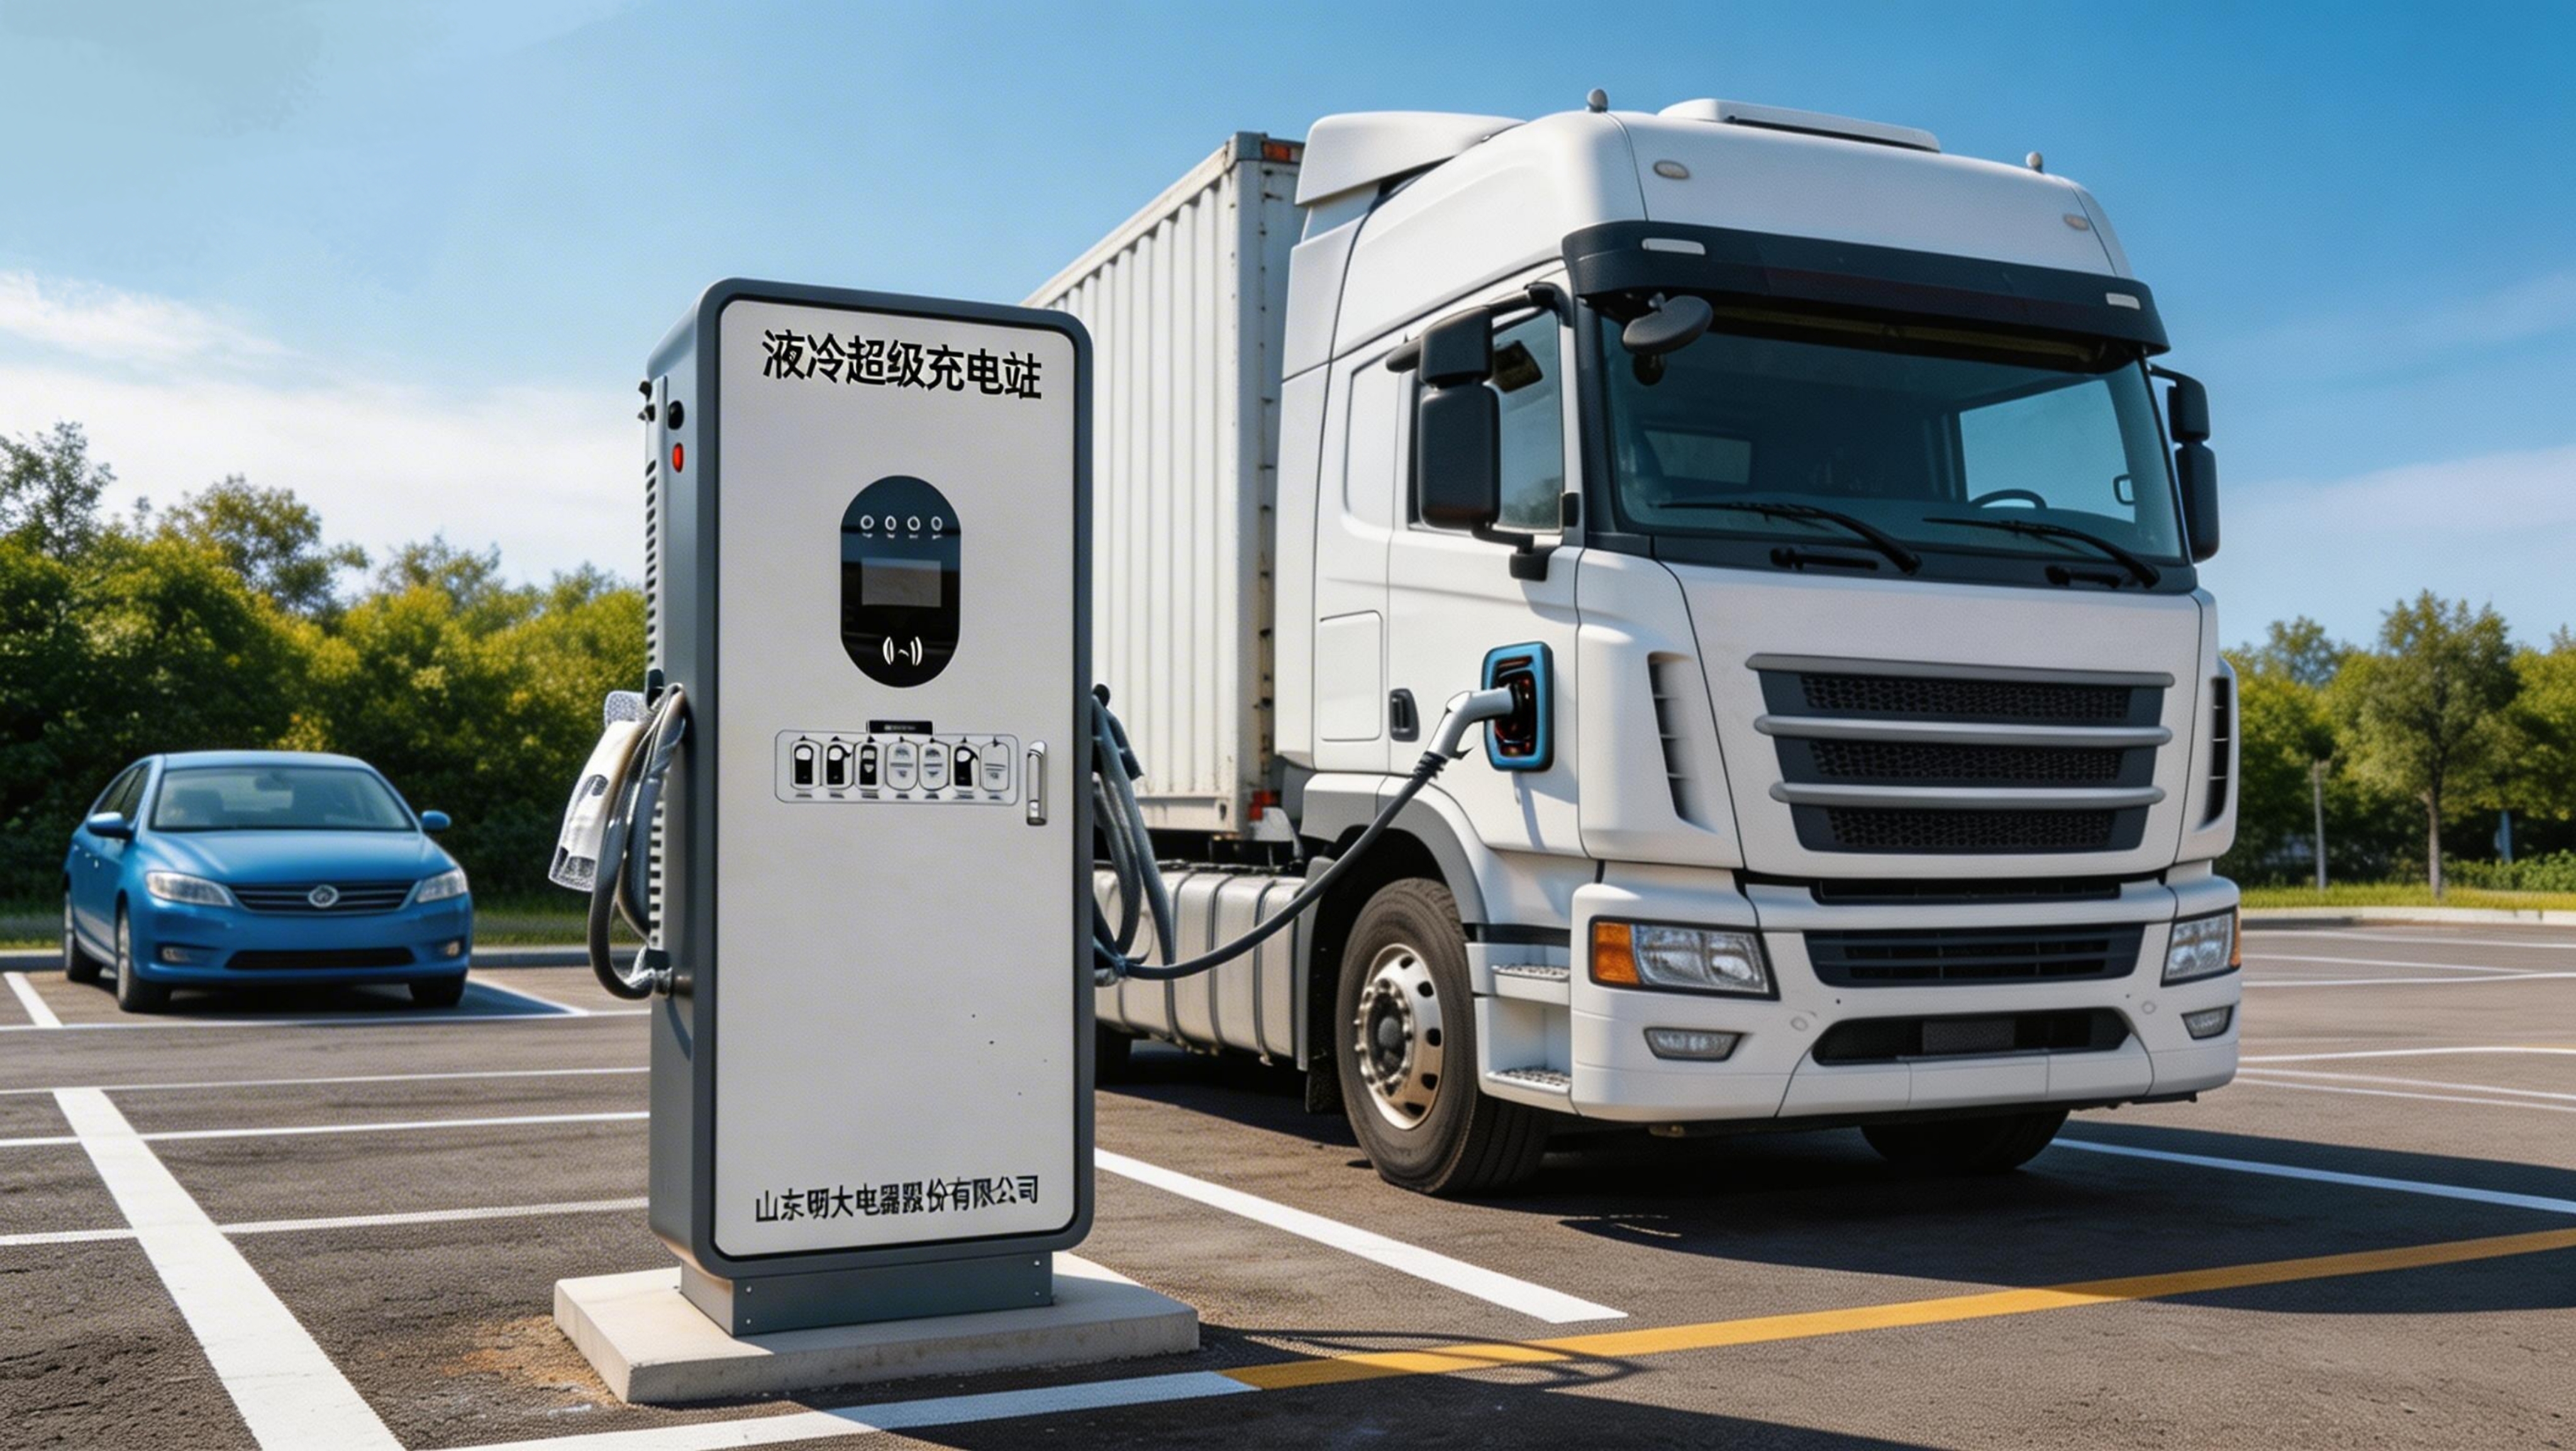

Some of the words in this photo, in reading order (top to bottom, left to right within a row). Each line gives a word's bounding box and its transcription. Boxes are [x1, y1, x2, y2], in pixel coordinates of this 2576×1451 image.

[762, 329, 1042, 399] 液冷超级充电站
